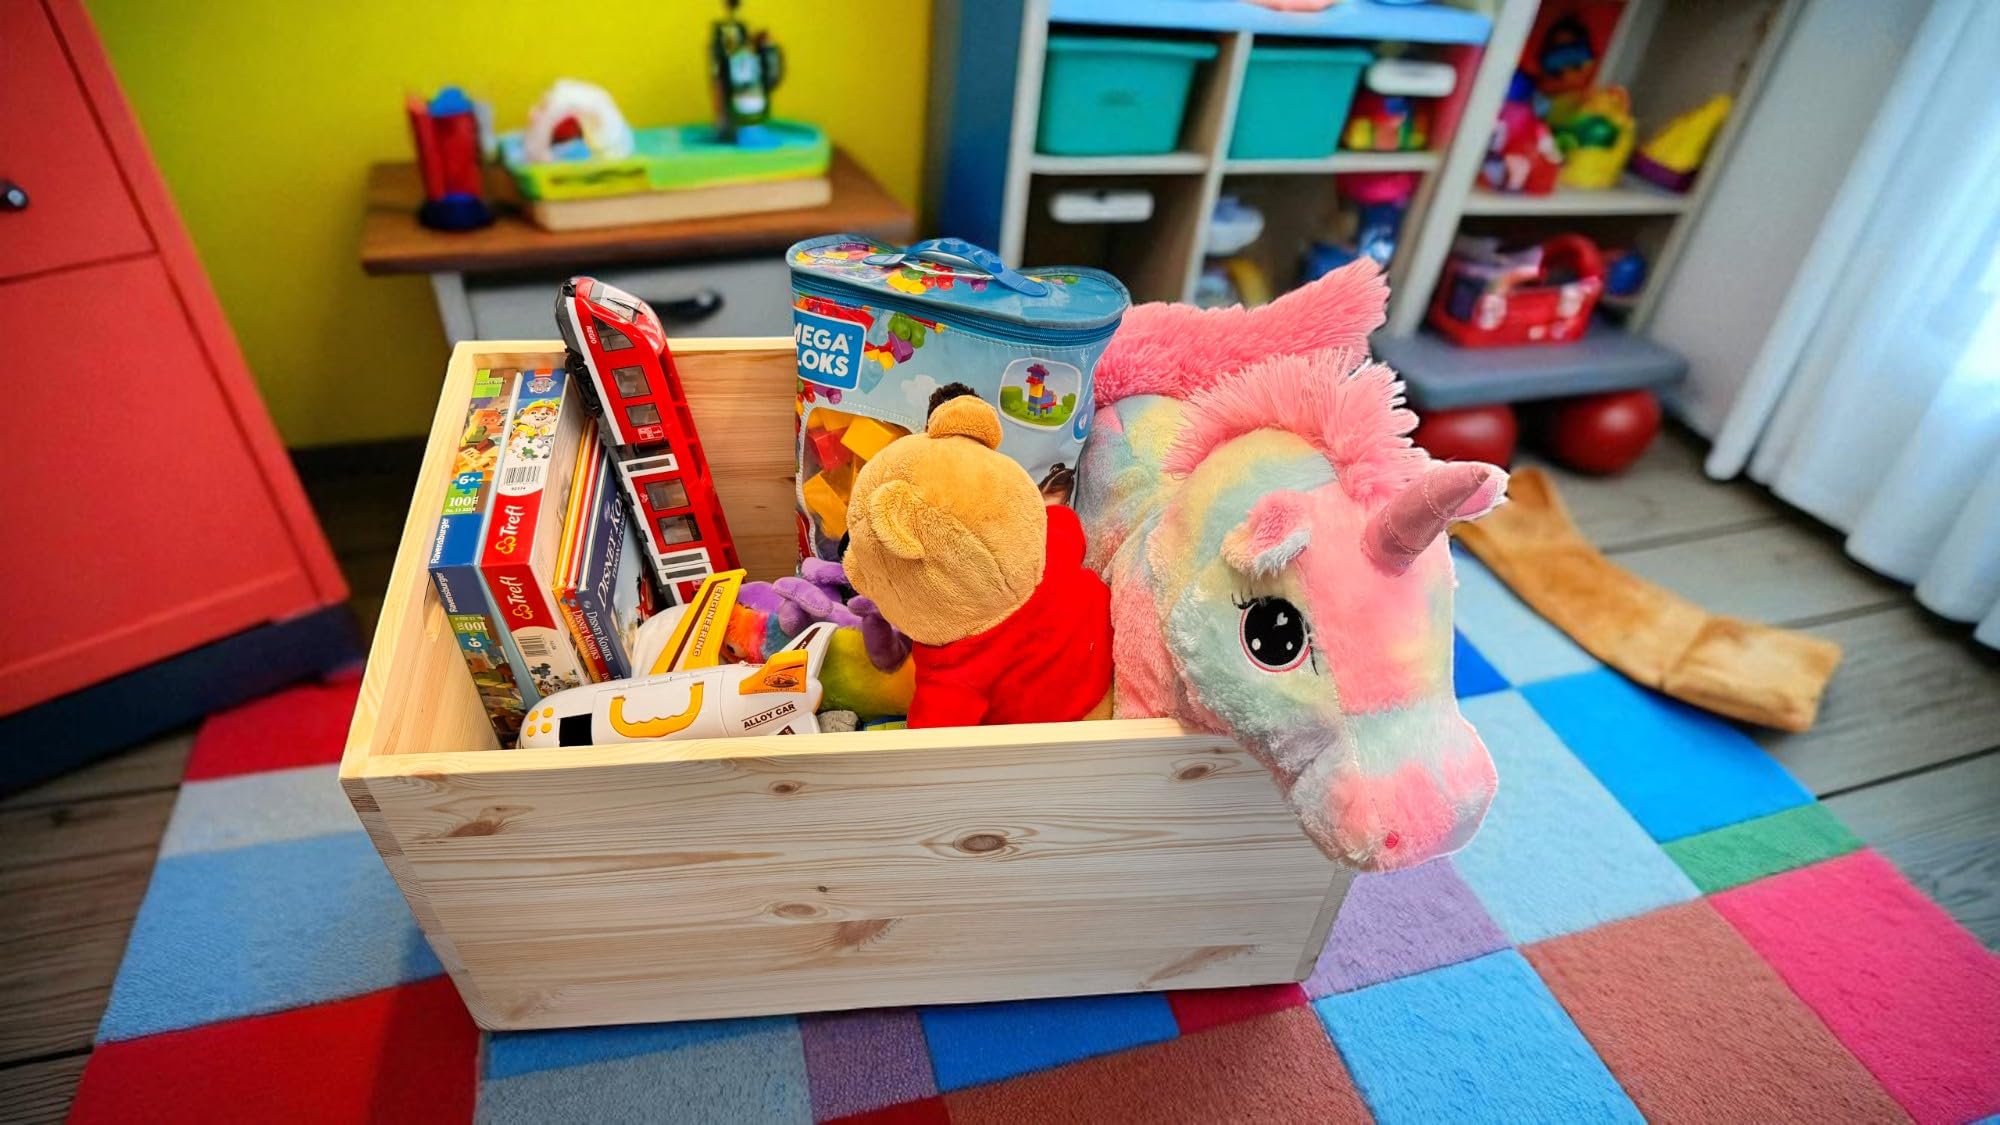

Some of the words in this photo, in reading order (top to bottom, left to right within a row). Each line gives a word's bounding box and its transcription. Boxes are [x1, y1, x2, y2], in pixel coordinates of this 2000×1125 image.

[459, 475, 476, 485] 6+
[449, 496, 472, 507] 100
[500, 504, 525, 536] Trefl
[597, 530, 617, 612] DISNEY
[436, 572, 458, 613] Ravensburger
[499, 576, 528, 605] Trefl
[465, 622, 487, 631] 100
[572, 609, 588, 635] DISNEY
[583, 631, 600, 660] KOMIKS
[587, 611, 602, 638] DISNEY
[597, 633, 613, 662] KOMIKS
[693, 586, 725, 657] ENGINEERING
[744, 711, 774, 728] ALLOY
[776, 703, 796, 716] CAR
